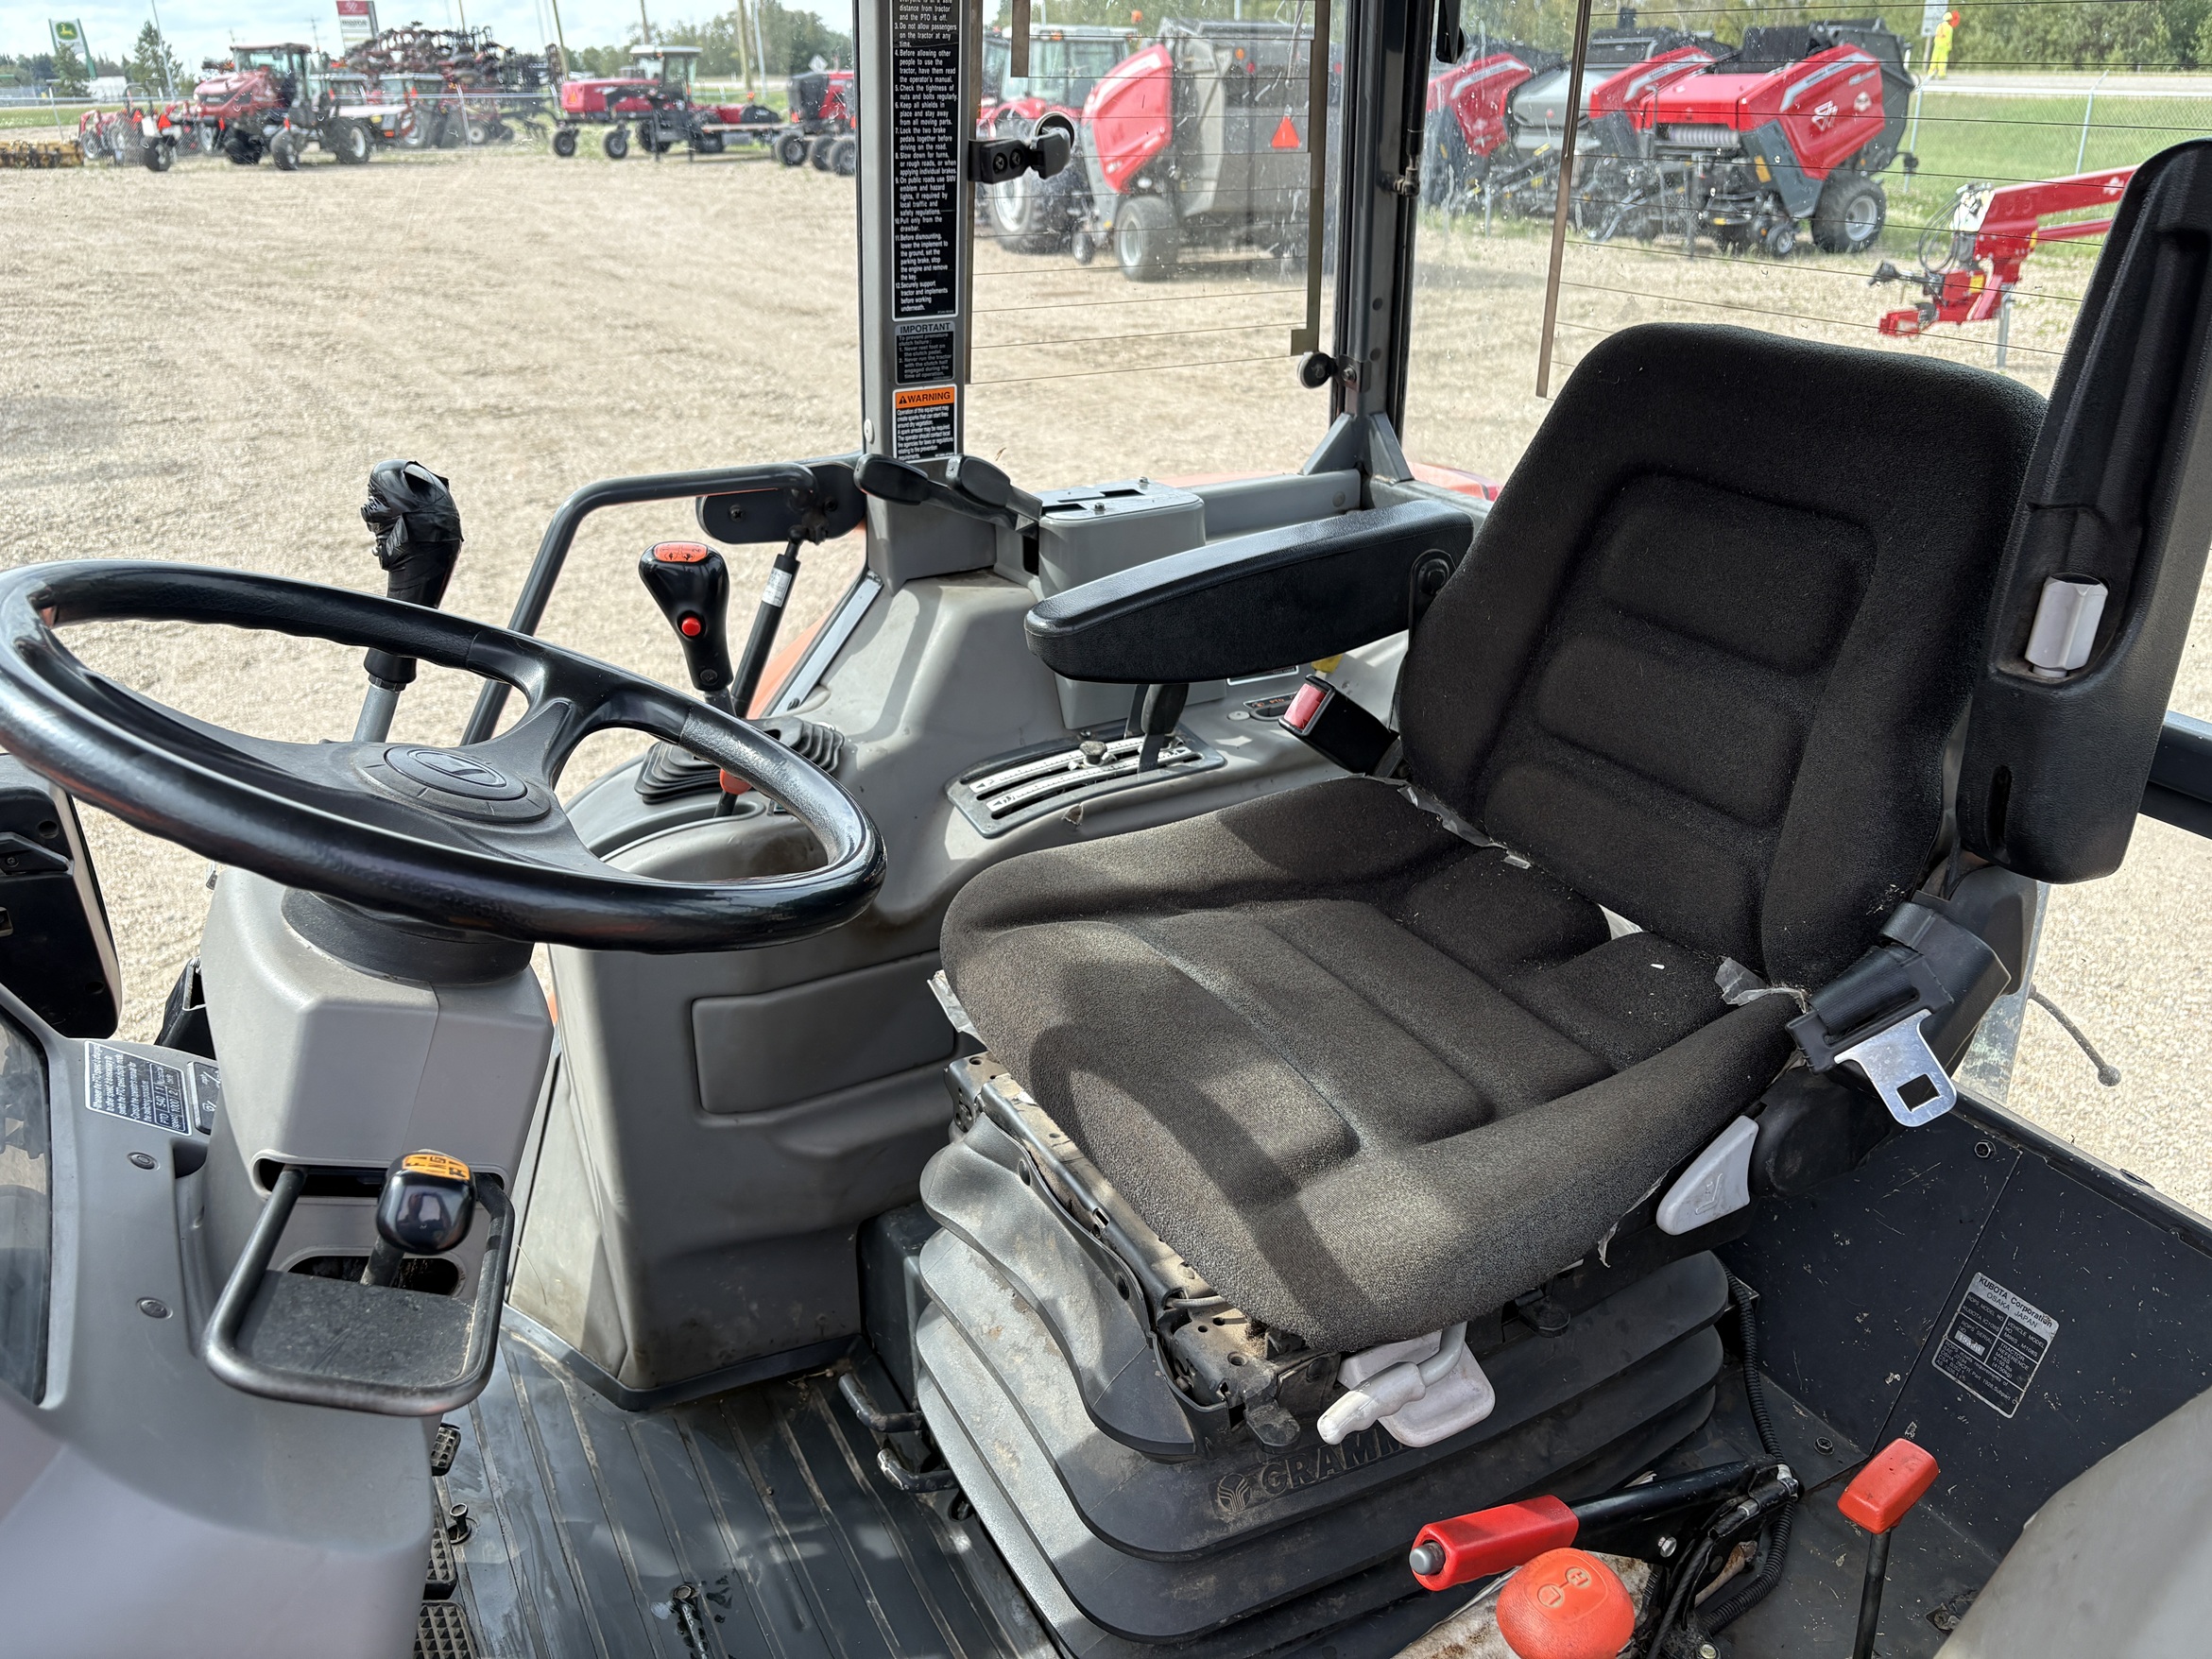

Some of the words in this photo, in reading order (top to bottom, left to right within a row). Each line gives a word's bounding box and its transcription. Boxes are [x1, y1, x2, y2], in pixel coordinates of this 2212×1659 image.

[900, 323, 951, 333] IMPORTANT
[908, 391, 950, 404] WARNING
[155, 1096, 166, 1108] 540
[170, 1098, 180, 1112] 1000
[159, 1113, 169, 1125] PTO
[1978, 1277, 2009, 1300] KUBOTA
[2009, 1296, 2054, 1329] Corporation
[1979, 1303, 1996, 1317] MODEL
[1986, 1292, 2011, 1311] OSAKA
[2014, 1310, 2038, 1329] JAPAN
[1962, 1304, 1983, 1321] KUBOTA
[1975, 1329, 1994, 1345] SERIAL
[2006, 1320, 2028, 1337] VEHICLE
[2027, 1334, 2046, 1349] MODEL
[1995, 1351, 2011, 1365] MASS
[1997, 1347, 2030, 1372] REFERENCE
[1999, 1342, 2026, 1362] TRACTOR
